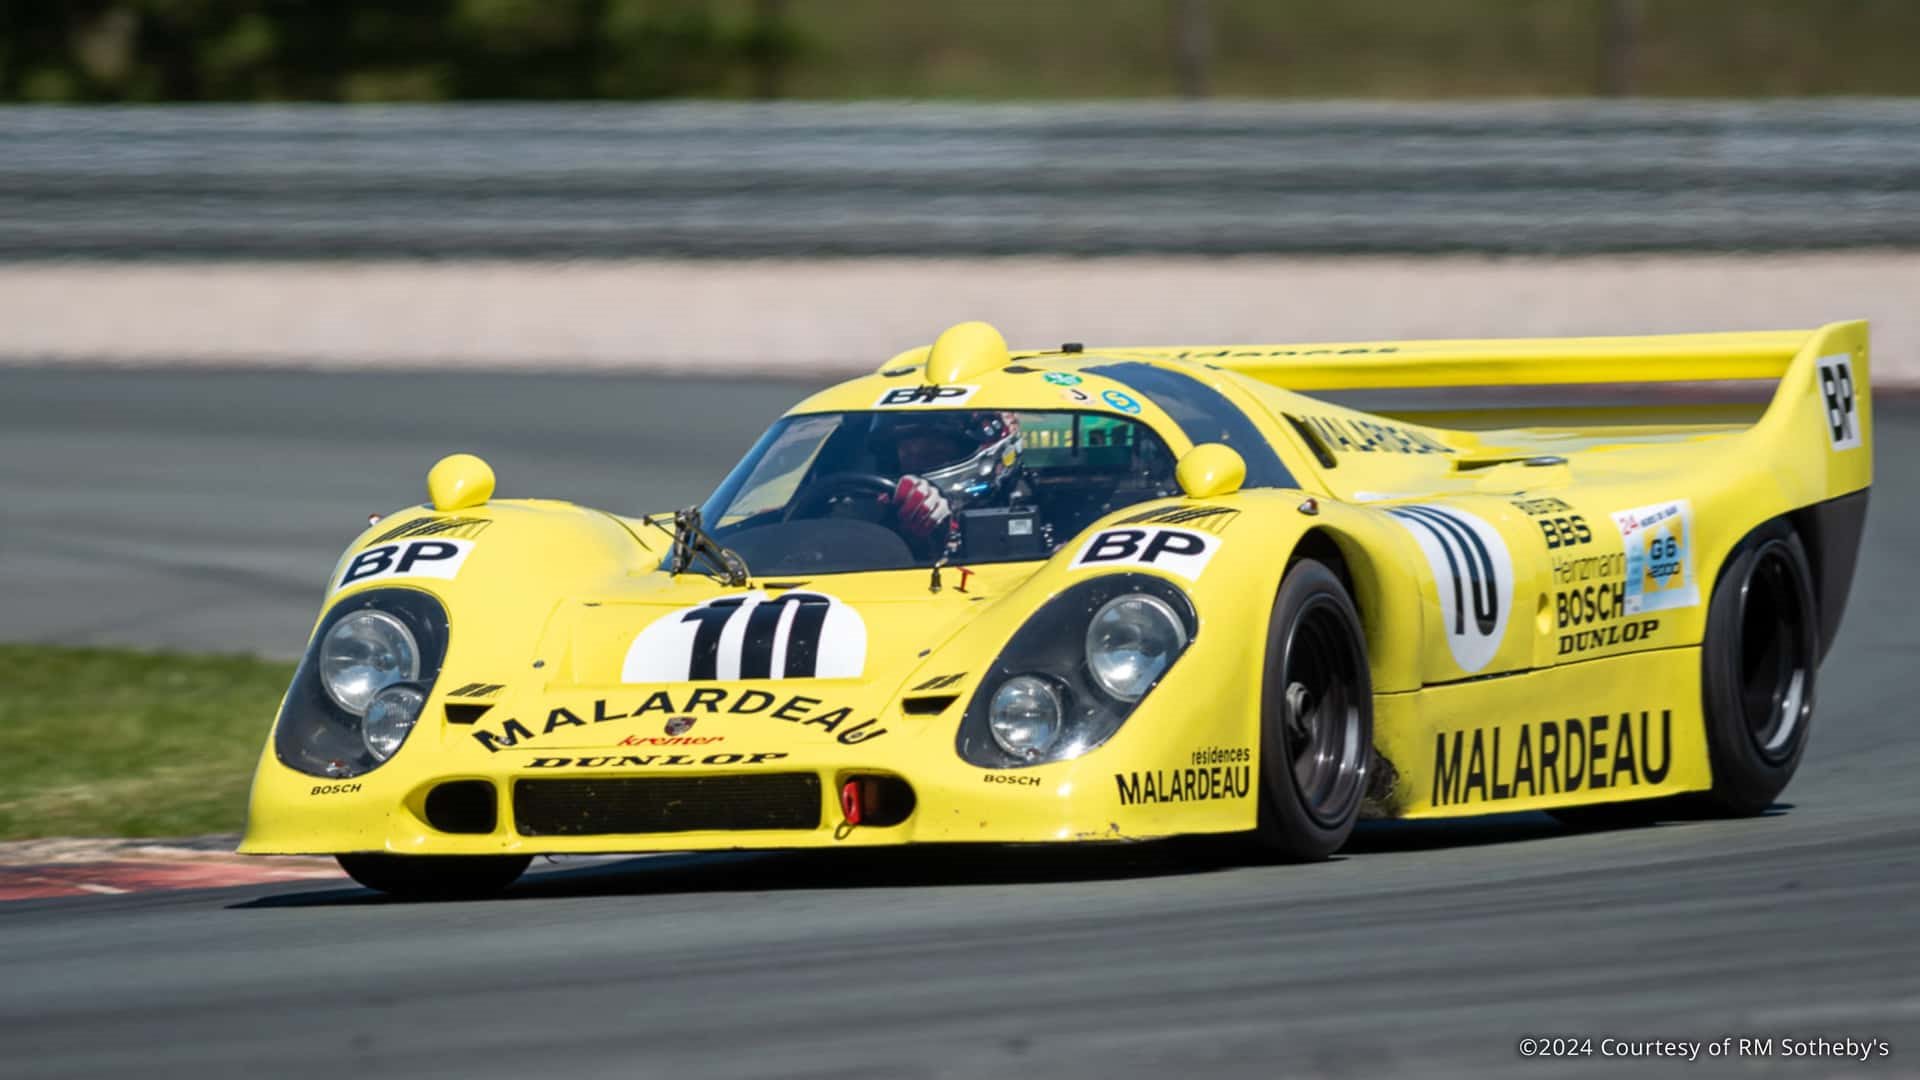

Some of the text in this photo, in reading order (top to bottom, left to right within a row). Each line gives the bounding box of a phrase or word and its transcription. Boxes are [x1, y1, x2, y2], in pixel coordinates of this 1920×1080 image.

[880, 386, 968, 405] BP
[1820, 363, 1853, 442] BP
[1079, 529, 1206, 564] BP
[1539, 515, 1592, 548] BBS
[1650, 535, 1678, 560] G6
[340, 541, 459, 588] BP
[1384, 505, 1499, 636] 10
[1552, 551, 1626, 585] Heinzmann
[1556, 581, 1626, 628] BOSCH
[680, 592, 831, 682] 10
[1558, 619, 1660, 655] DUNLOP
[471, 688, 888, 753] MALARDEAU
[617, 734, 725, 746] kremer
[1191, 747, 1250, 766] résidences
[523, 753, 789, 769] DUNLOP
[1431, 709, 1672, 807] MALARDEAU
[311, 783, 362, 796] BOSCH
[983, 774, 1041, 787] BOSCH
[1114, 766, 1250, 805] MALARDEAU
